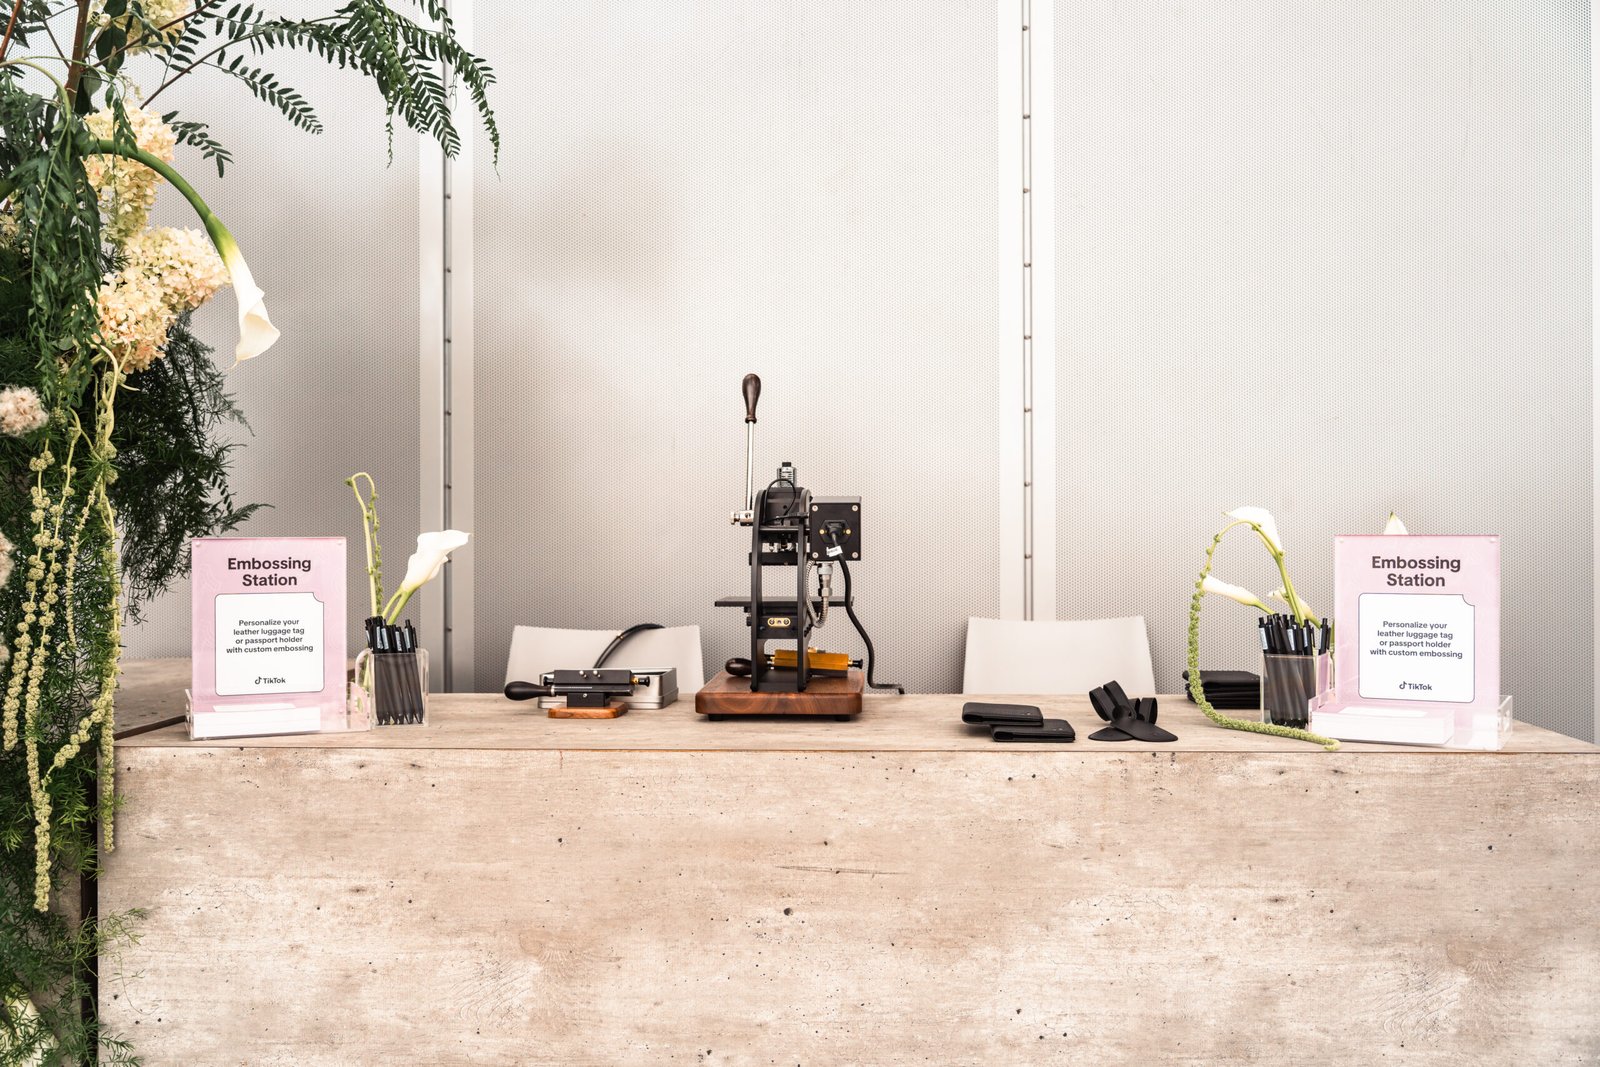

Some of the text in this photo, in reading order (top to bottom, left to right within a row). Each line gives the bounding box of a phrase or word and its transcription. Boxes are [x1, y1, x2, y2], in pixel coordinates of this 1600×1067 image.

[227, 557, 311, 572] Embossing
[1372, 556, 1461, 572] Embossing
[242, 573, 297, 586] Station
[1386, 573, 1445, 587] Station
[239, 619, 299, 627] Personalize your
[1383, 621, 1428, 629] Personalize
[233, 628, 259, 636] leather
[261, 628, 291, 636] luggage
[1377, 630, 1405, 638] leather
[1406, 631, 1438, 639] luggage
[245, 637, 278, 645] passport
[1389, 640, 1424, 648] passport
[226, 646, 243, 654] with
[1370, 648, 1387, 656] with
[1419, 650, 1463, 659] embossing
